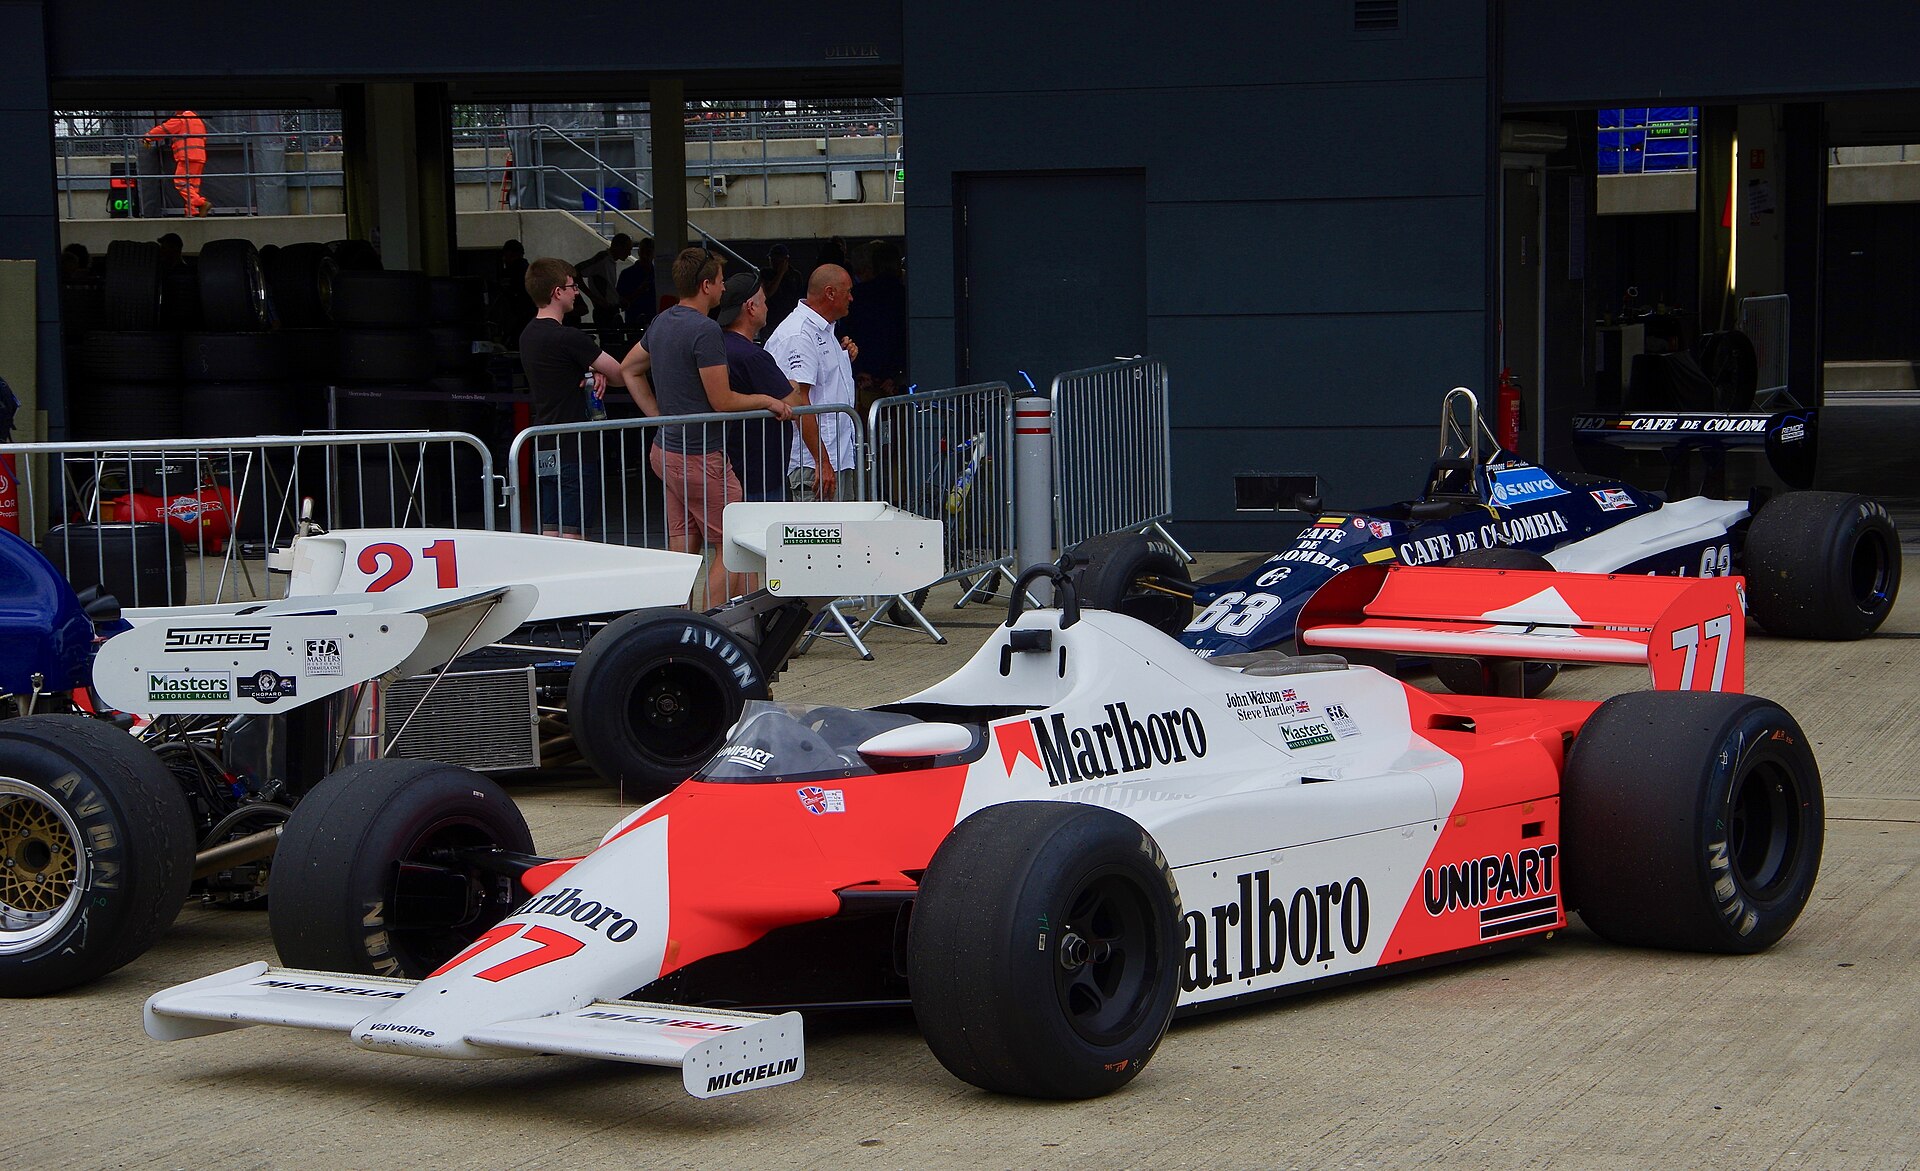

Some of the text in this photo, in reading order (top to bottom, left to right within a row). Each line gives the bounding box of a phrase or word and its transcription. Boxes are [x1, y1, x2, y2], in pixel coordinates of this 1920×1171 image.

[824, 45, 880, 57] OLIVER
[1631, 418, 1766, 432] CAFE DE COLOM
[1505, 478, 1555, 496] SANYO
[0, 499, 16, 508] LOR
[784, 526, 840, 538] Masters
[1296, 527, 1348, 544] CAFE
[1297, 540, 1321, 550] DE
[1400, 533, 1454, 566] CAFE
[1456, 531, 1478, 552] DE
[357, 539, 459, 593] 21
[1264, 549, 1350, 573] LOMBIA
[1183, 591, 1282, 637] 63
[164, 626, 272, 652] SURTEES
[680, 626, 757, 689] AVON
[1671, 612, 1731, 692] 77
[150, 674, 228, 691] Masters
[1226, 690, 1282, 709] John Watson
[1237, 703, 1296, 722] Steve Hartley
[1280, 723, 1329, 742] Masters
[1030, 702, 1208, 787] Marlboro
[1289, 739, 1313, 749] HISTORIC
[717, 745, 775, 764] UNIPART
[51, 770, 121, 890] AVON
[1424, 843, 1559, 917] UNIPART
[1181, 869, 1370, 993] arlboro
[423, 922, 587, 983] 77
[370, 1023, 436, 1038] Valvoline
[706, 1057, 799, 1093] MICHELIN
